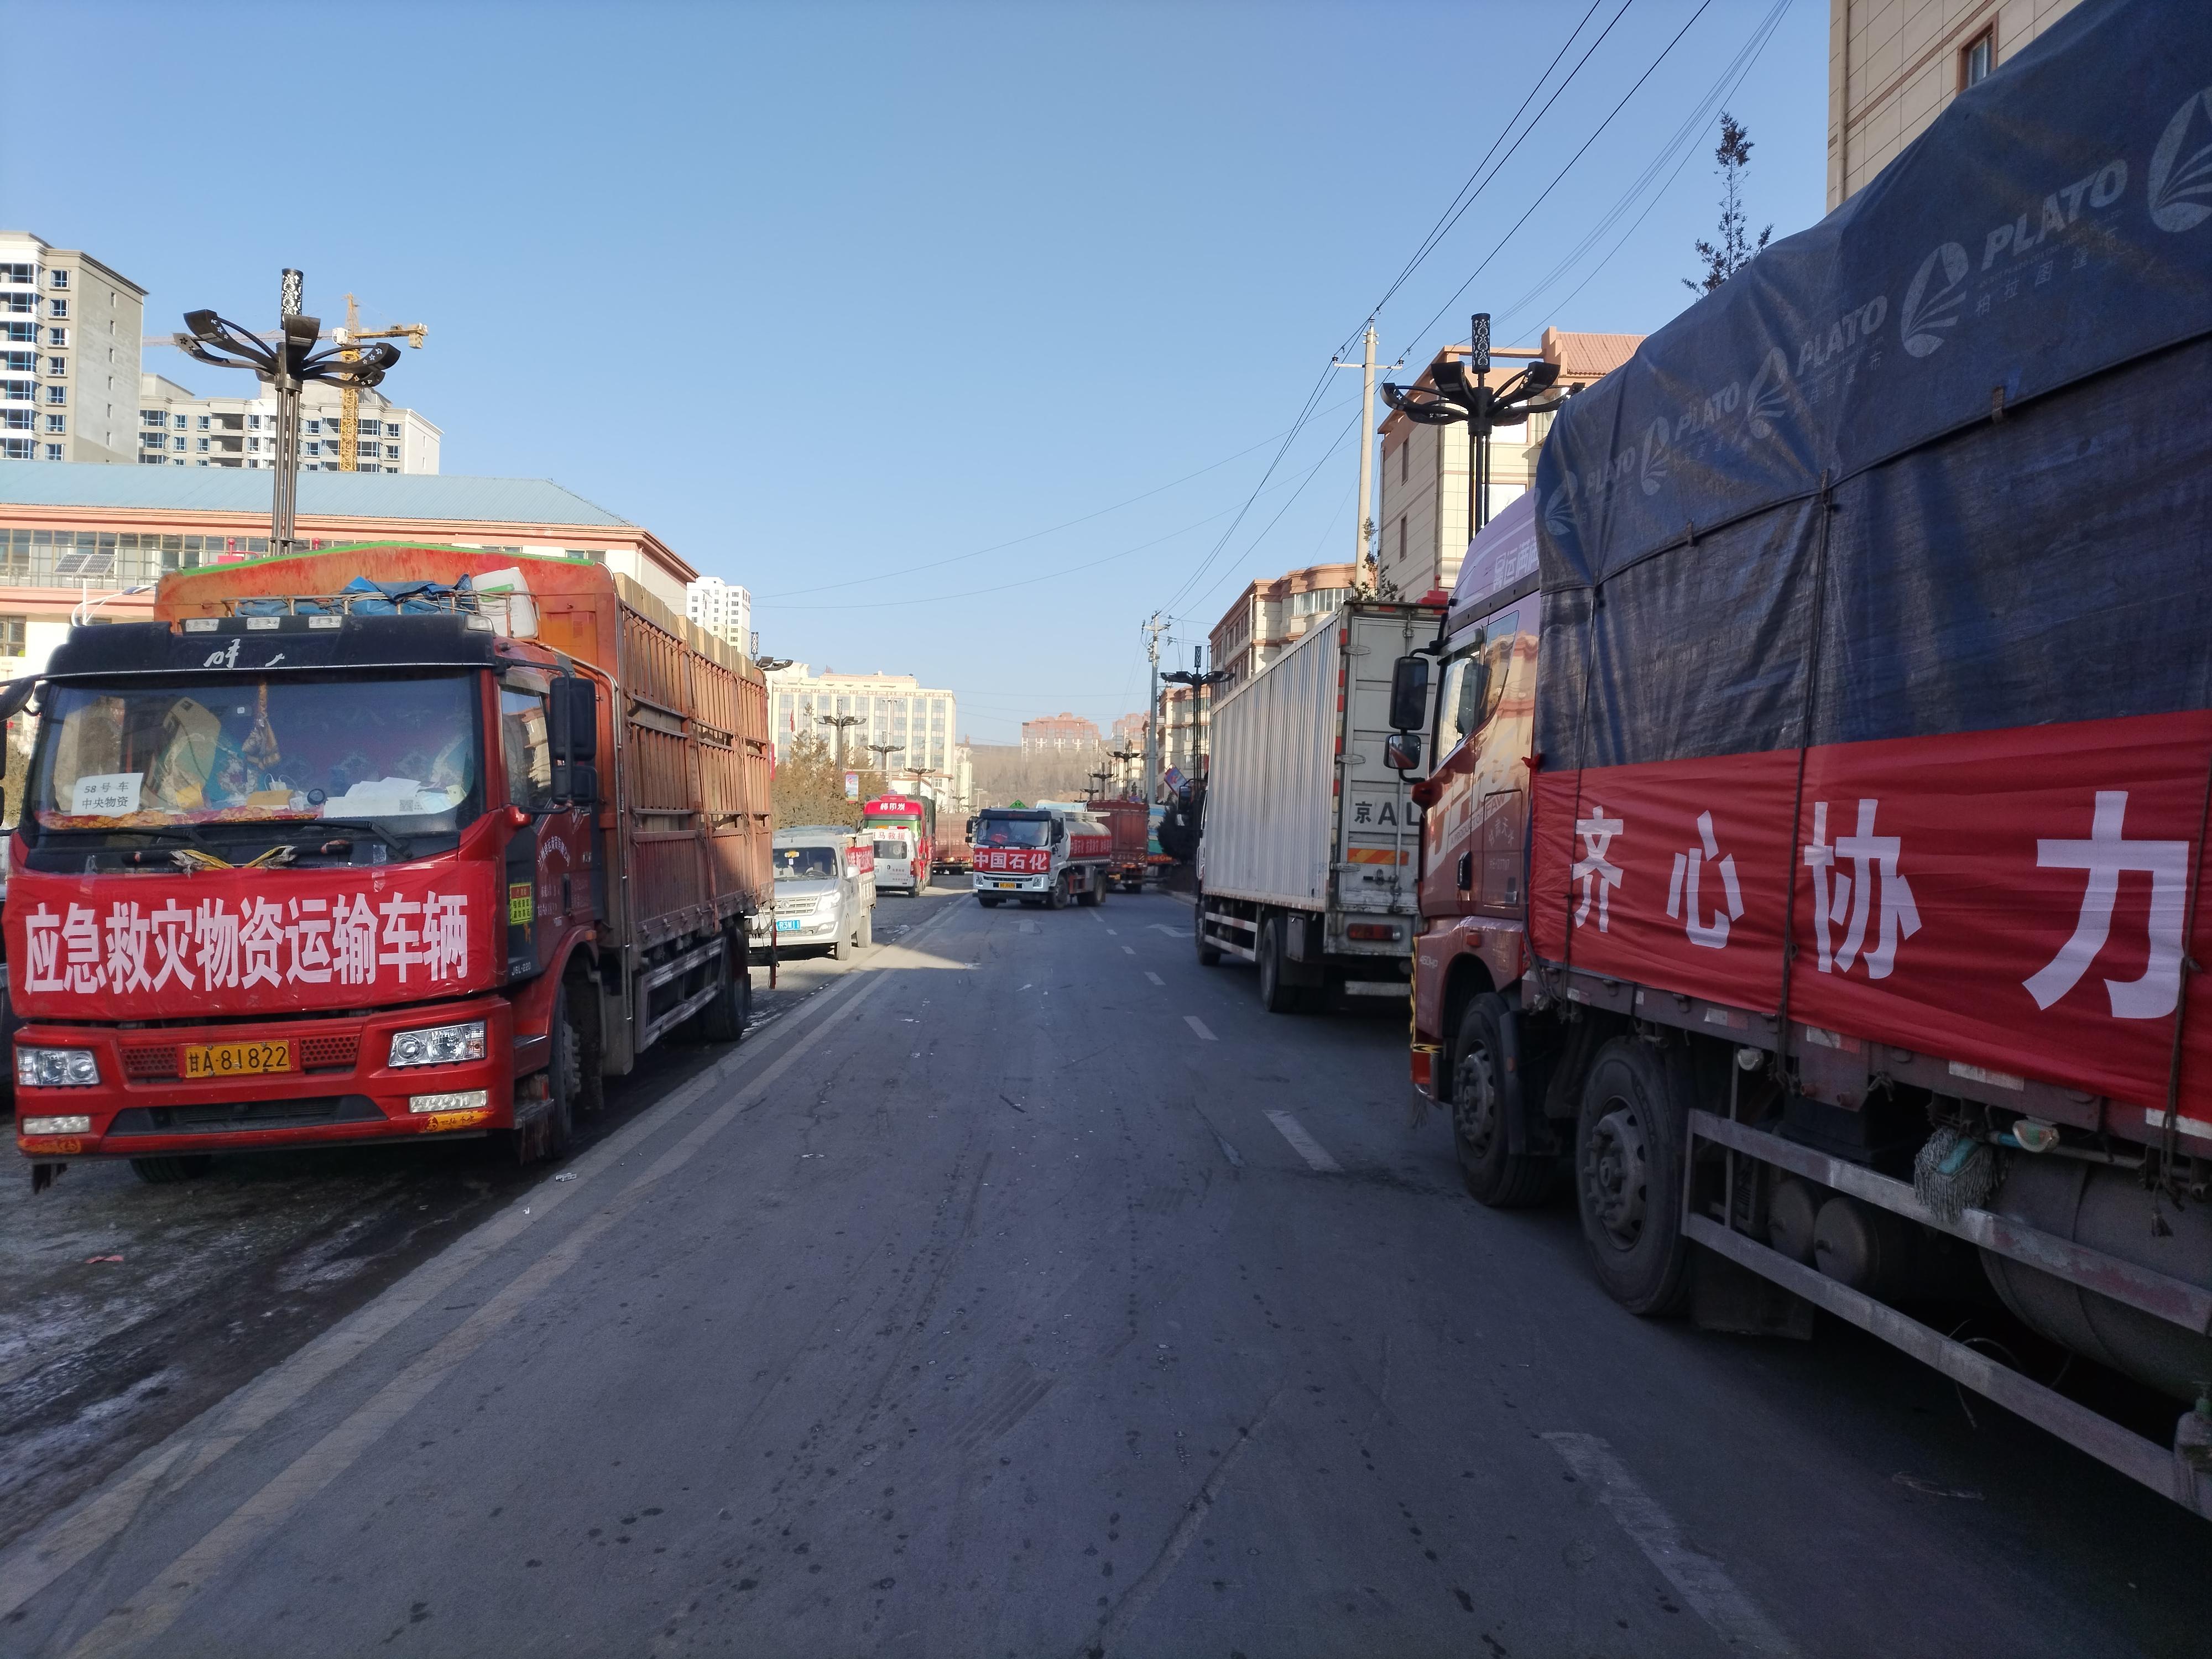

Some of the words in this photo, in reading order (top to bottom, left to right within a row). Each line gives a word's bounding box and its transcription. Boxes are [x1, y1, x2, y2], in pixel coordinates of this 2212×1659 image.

[1981, 159, 2127, 272] PLATO
[1796, 295, 1887, 377] PLATO
[1674, 382, 1740, 442] PLATO
[1585, 447, 1635, 498] PLATO
[82, 796, 129, 810] 中央物资
[1485, 794, 1505, 818] FAW
[974, 852, 1047, 870] 中国石化
[1570, 791, 2190, 1019] 齐心协力
[25, 891, 468, 994] 应急救灾物资运输车辆
